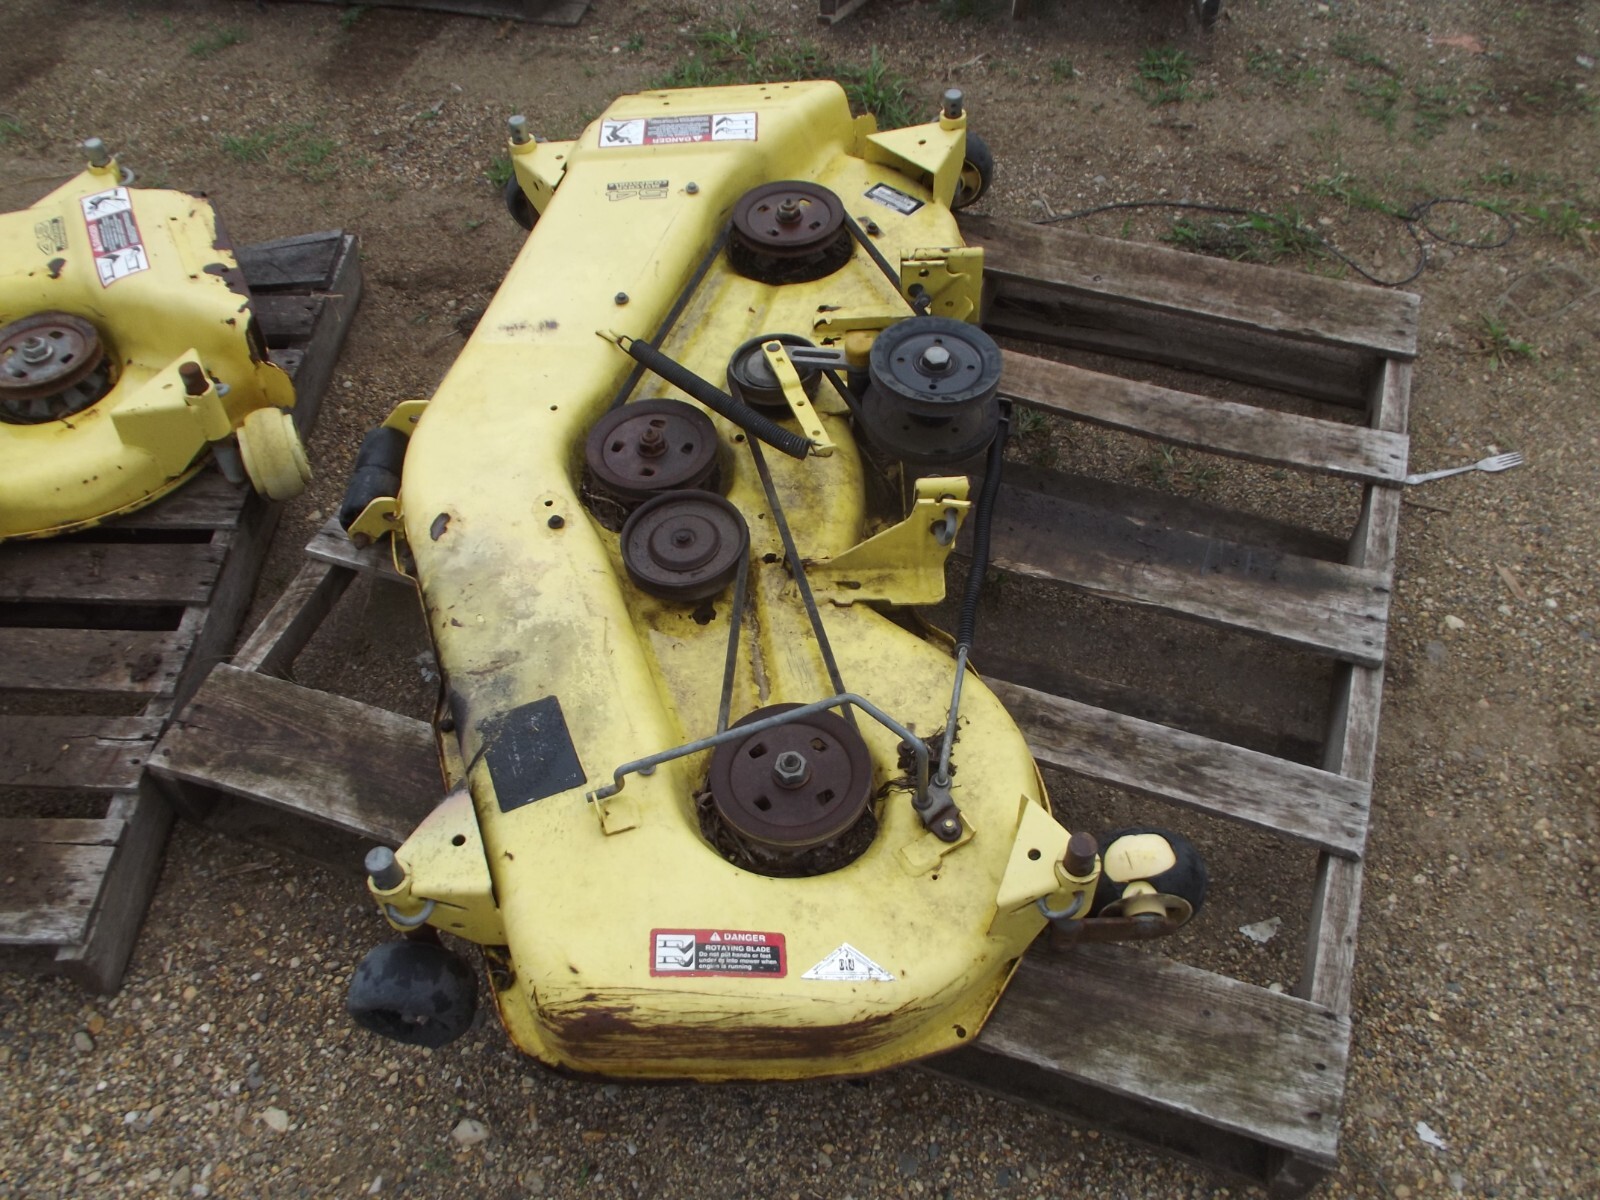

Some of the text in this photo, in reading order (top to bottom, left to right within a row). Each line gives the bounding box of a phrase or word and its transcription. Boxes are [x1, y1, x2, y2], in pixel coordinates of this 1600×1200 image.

[652, 136, 691, 144] DANGER
[723, 932, 766, 942] DANGER
[705, 944, 771, 953] ROTATING BLADE
